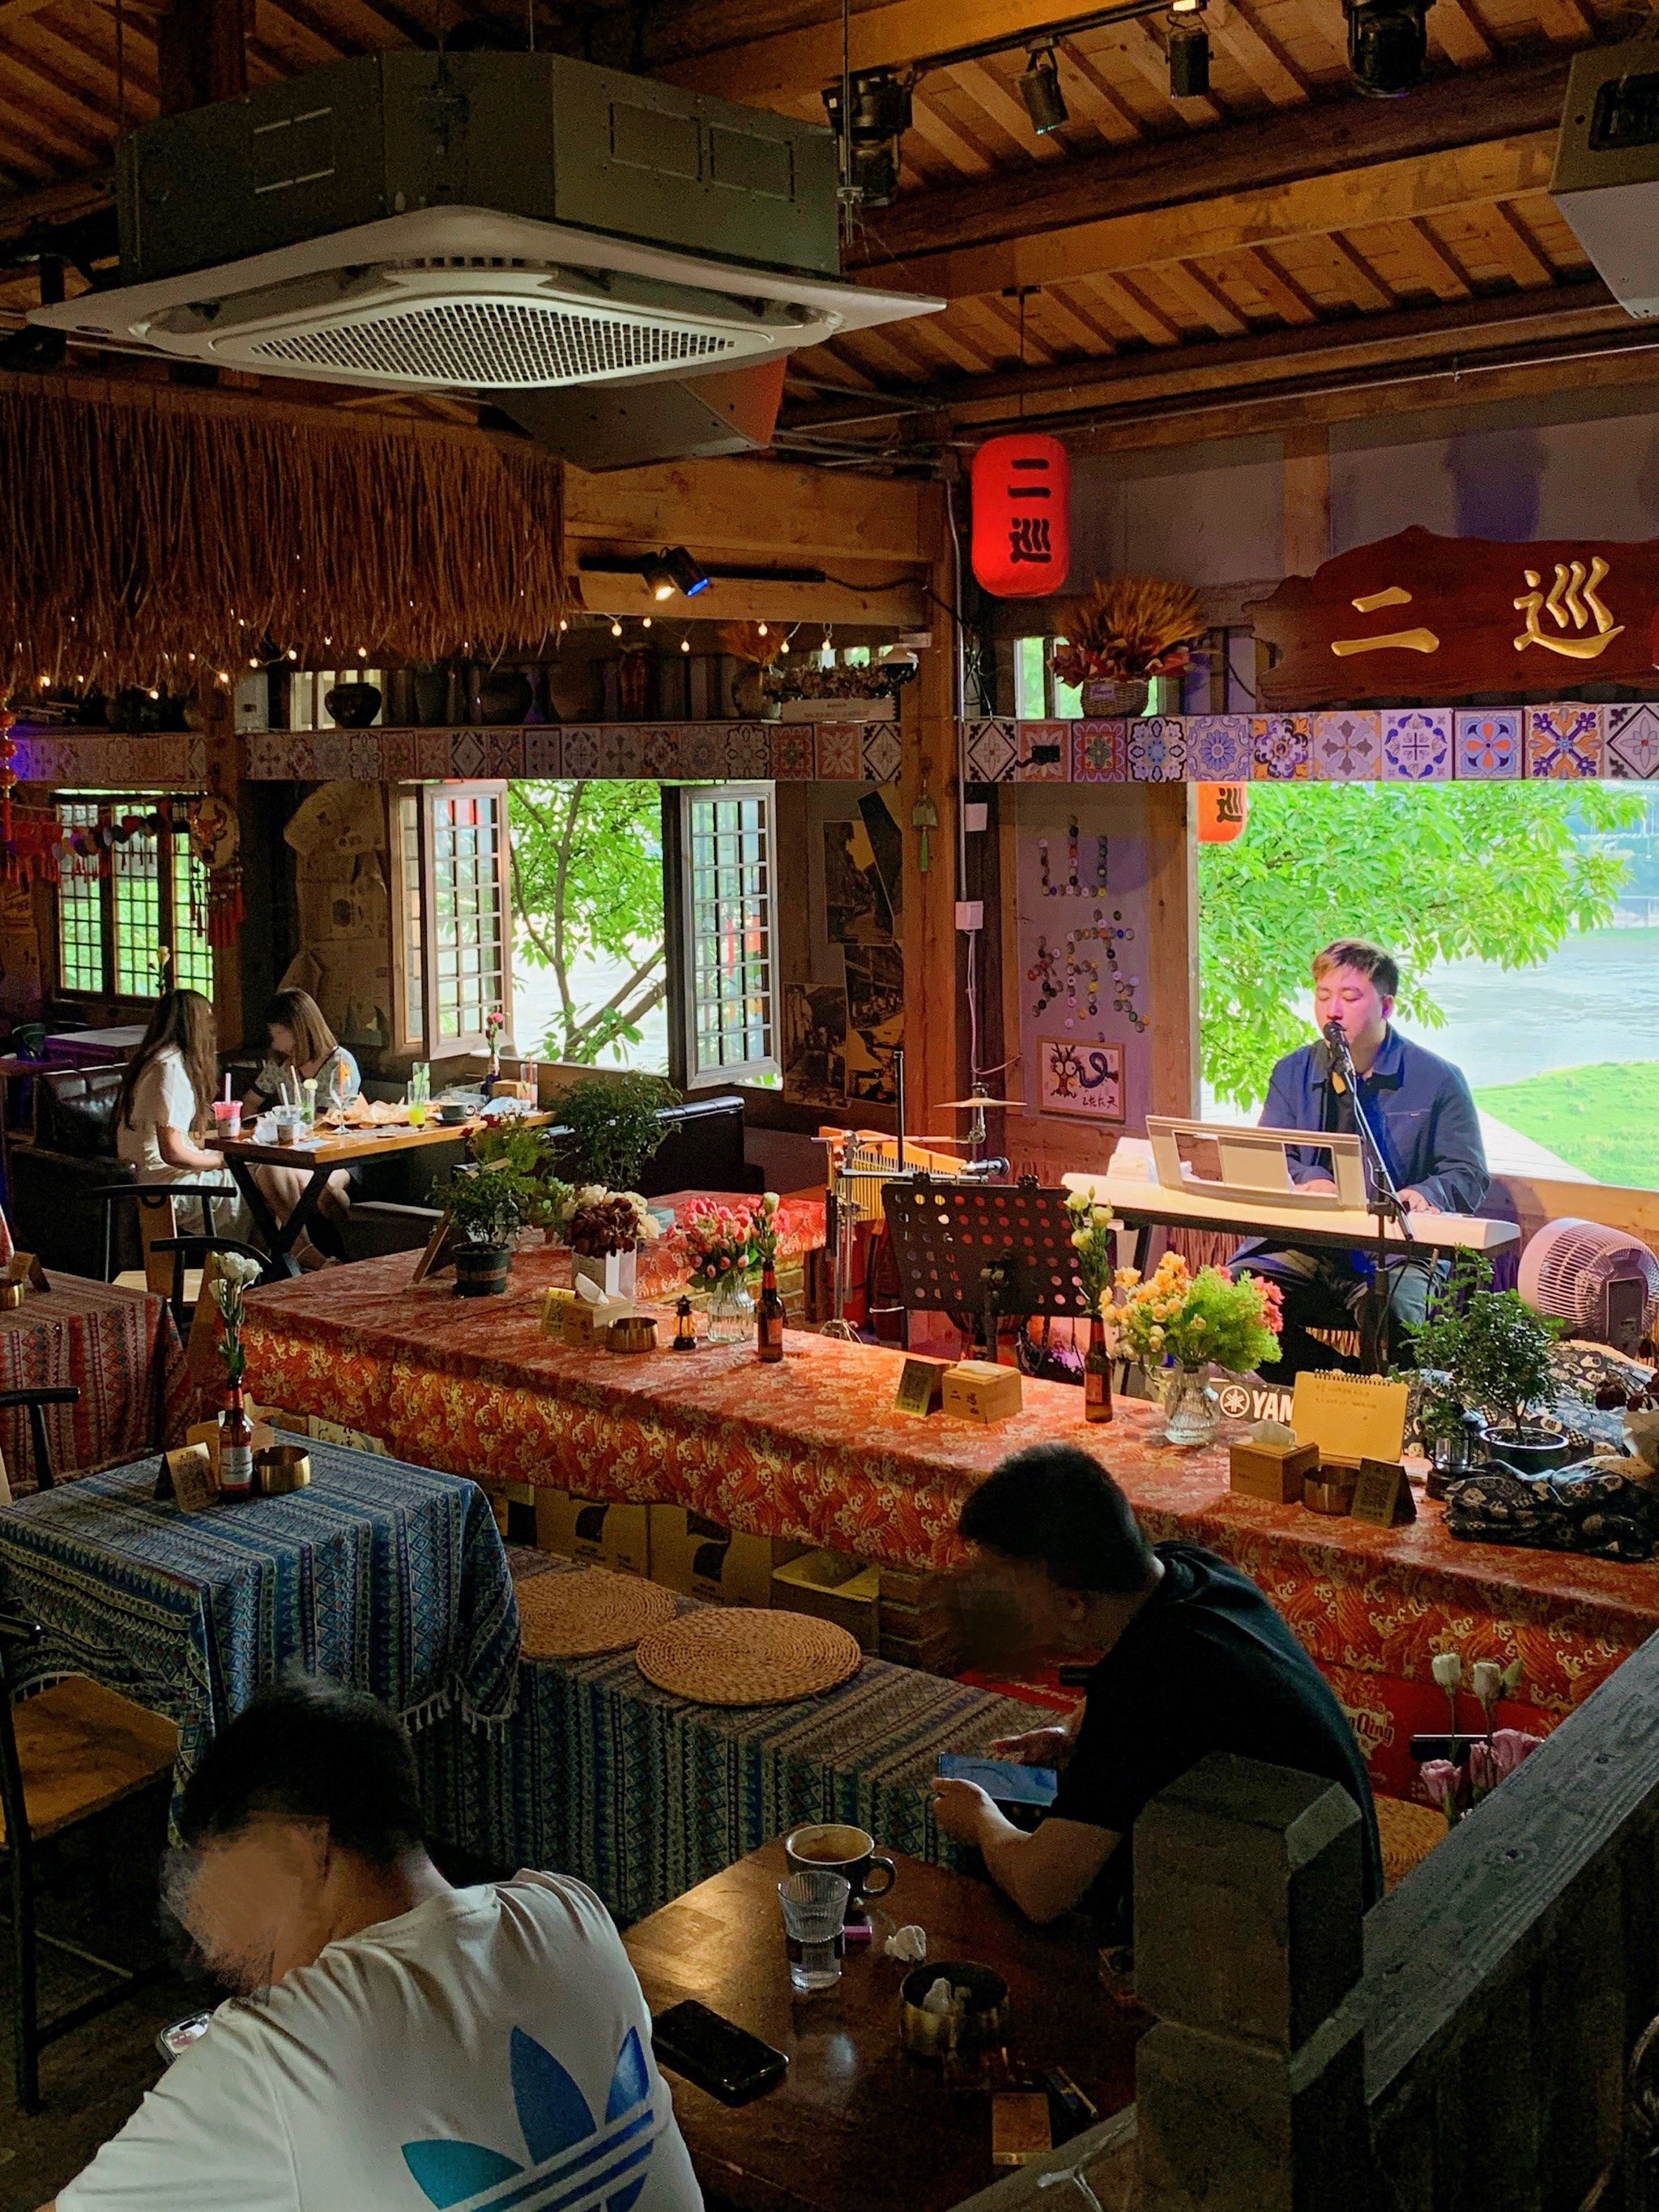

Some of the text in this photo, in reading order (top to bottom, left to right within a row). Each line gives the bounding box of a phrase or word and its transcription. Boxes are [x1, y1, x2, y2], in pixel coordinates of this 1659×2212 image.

[1008, 458, 1052, 564] 二巡
[1331, 556, 1626, 659] 二巡
[1216, 787, 1243, 823] 巡
